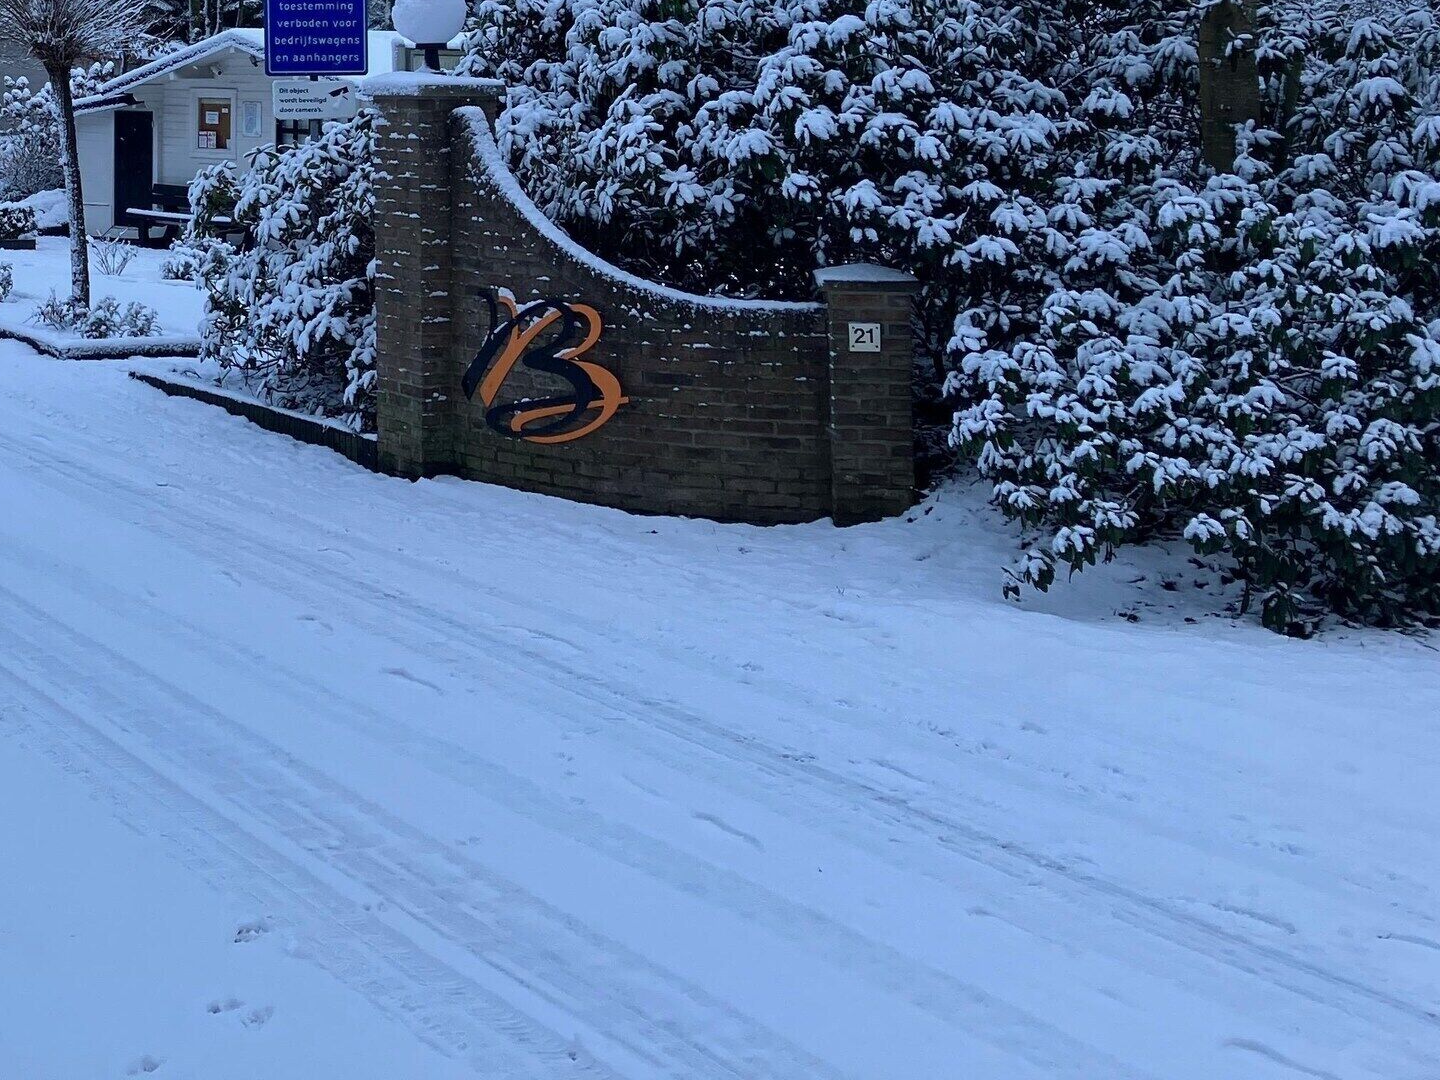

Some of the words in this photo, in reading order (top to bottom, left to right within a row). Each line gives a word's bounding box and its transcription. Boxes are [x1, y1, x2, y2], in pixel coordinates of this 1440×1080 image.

[279, 2, 354, 14] toestemming
[276, 19, 329, 28] verboden
[332, 19, 357, 28] voor
[274, 36, 360, 47] bedrijfswagens
[275, 54, 289, 62] en
[292, 52, 360, 64] aanhangers
[289, 87, 309, 95] object
[853, 327, 874, 344] 21
